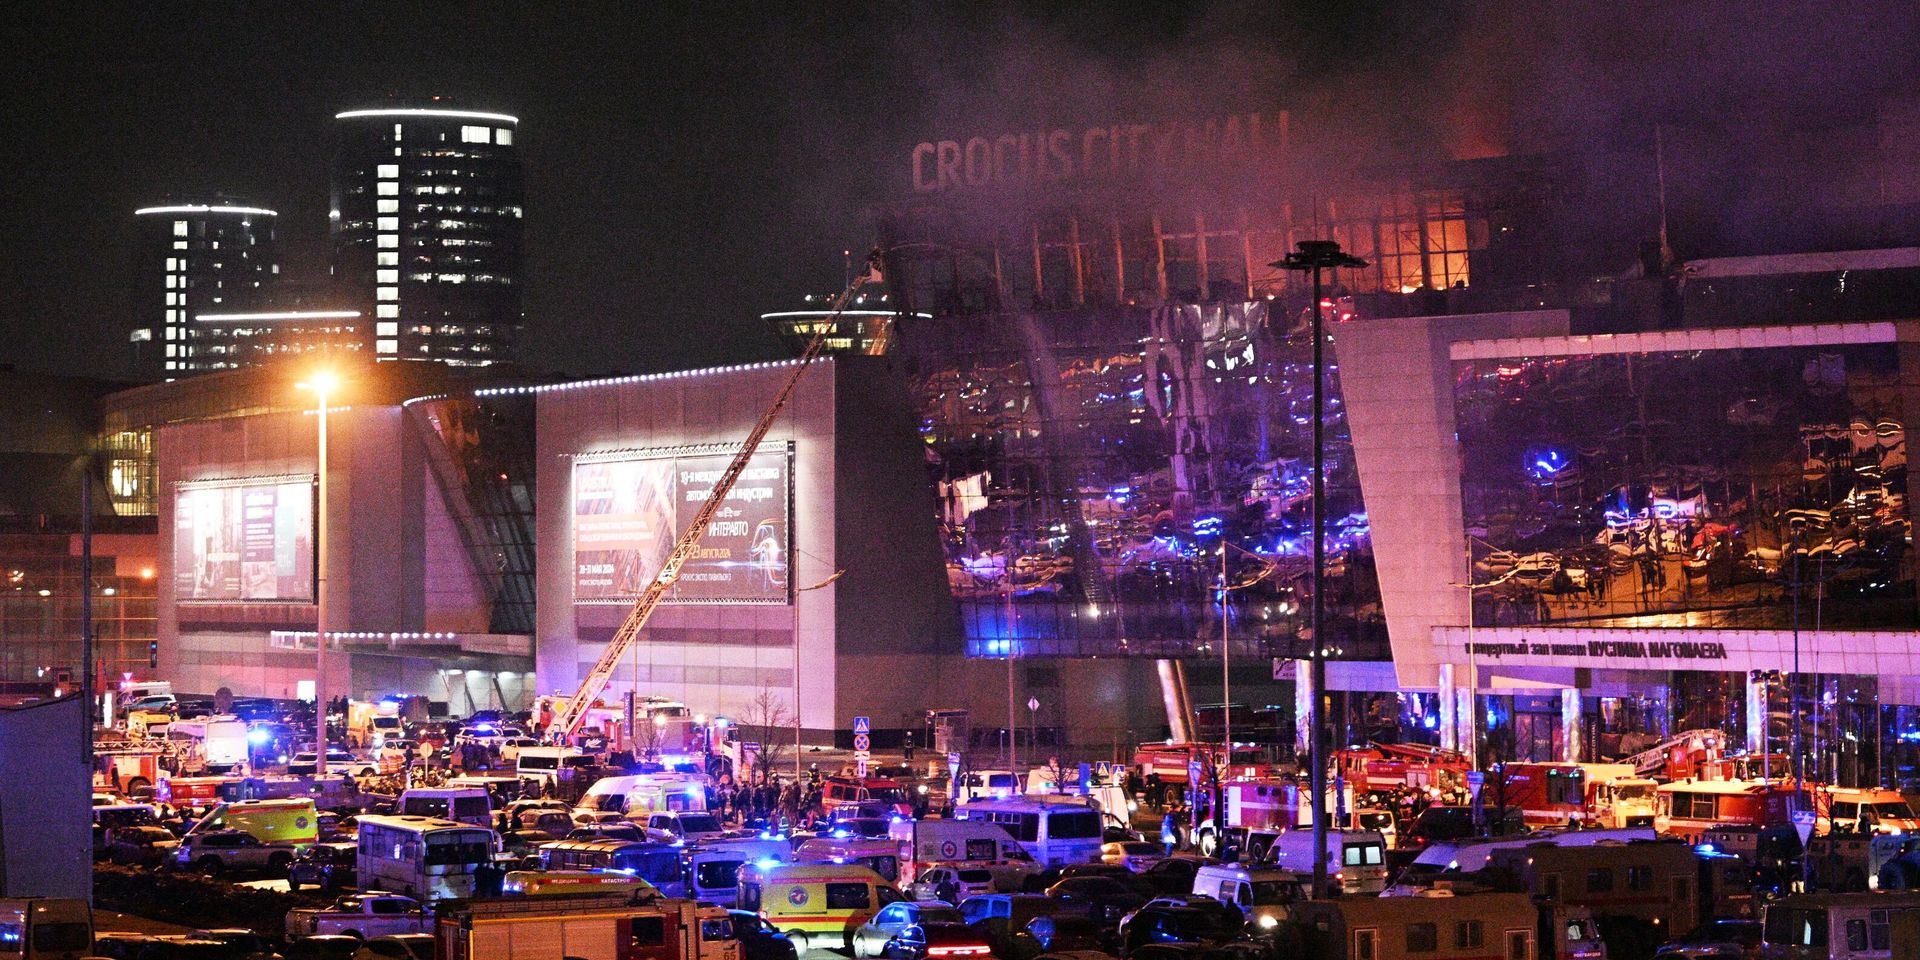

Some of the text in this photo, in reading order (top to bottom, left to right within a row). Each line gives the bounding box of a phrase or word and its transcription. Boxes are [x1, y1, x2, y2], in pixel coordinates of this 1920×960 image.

[911, 128, 1073, 191] CROCUS
[708, 521, 749, 537] ИНТЕРАВТО
[1530, 643, 1549, 655] зал
[1552, 644, 1586, 656] имени
[1588, 641, 1647, 659] МУСЛИМА
[1648, 642, 1727, 660] МАГОМАЕВА
[723, 951, 736, 960] 65
